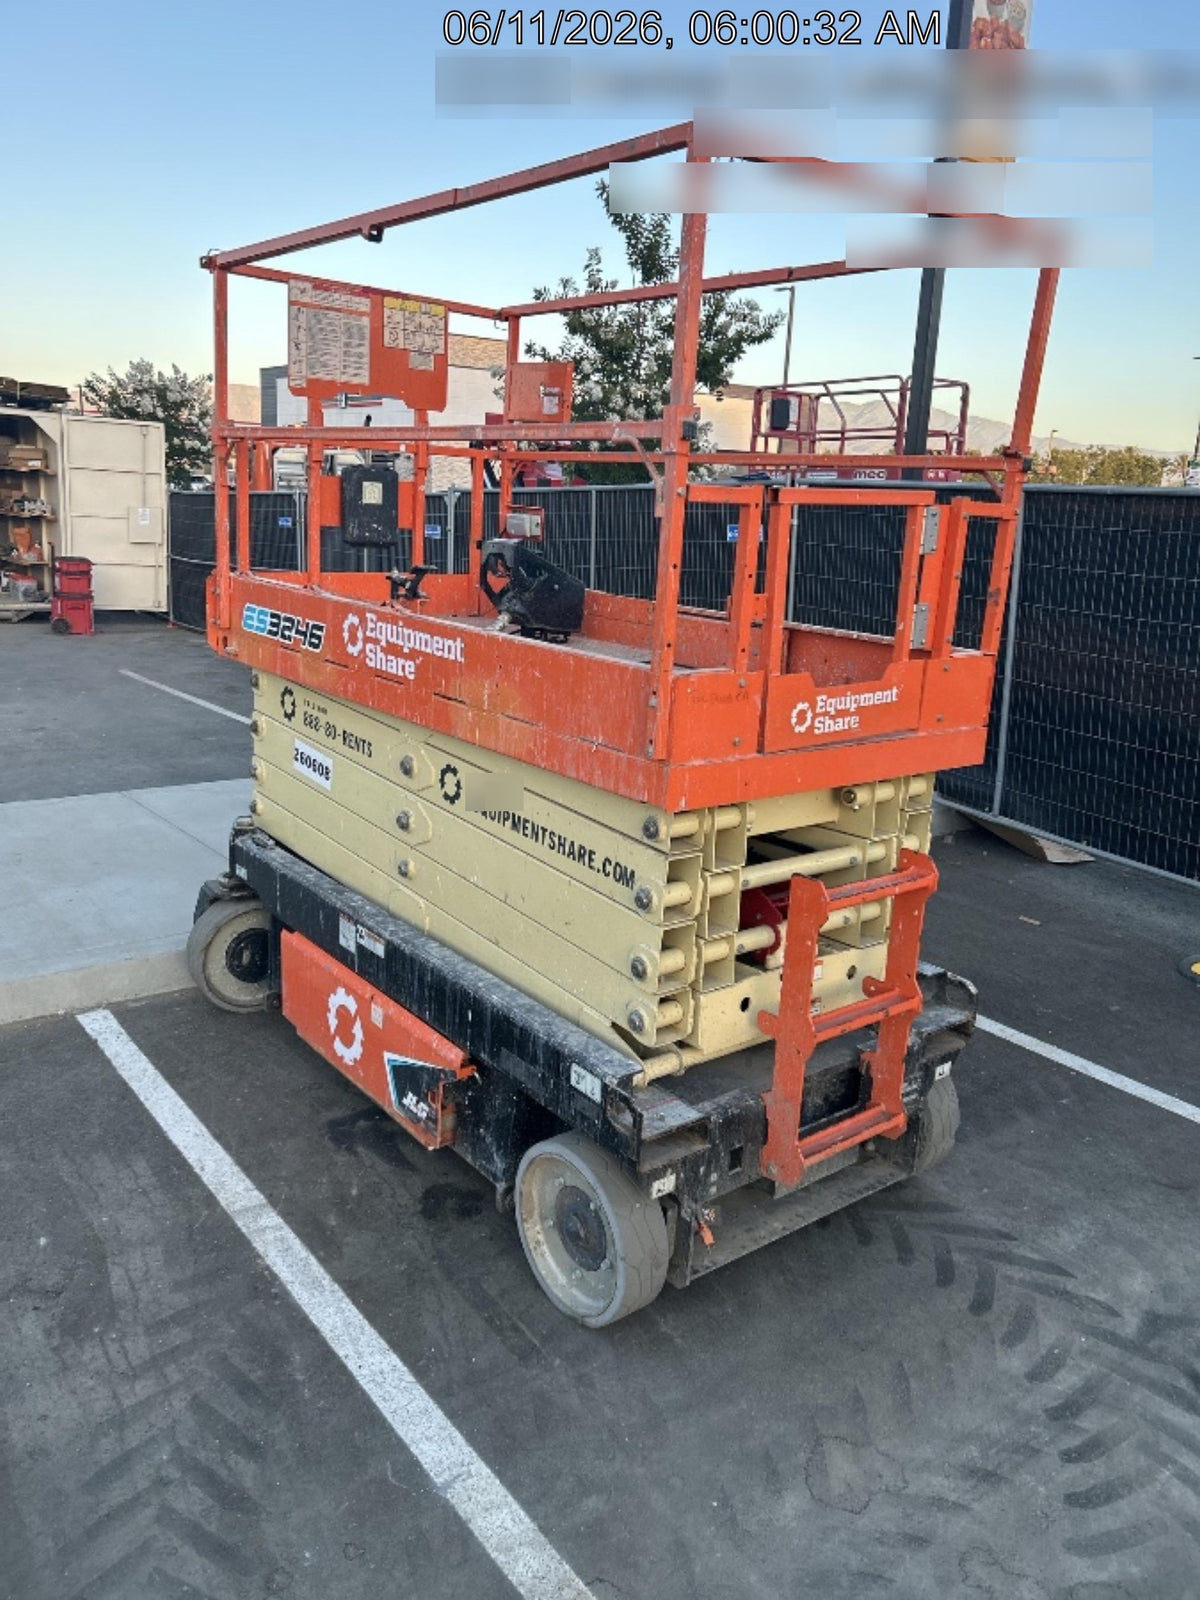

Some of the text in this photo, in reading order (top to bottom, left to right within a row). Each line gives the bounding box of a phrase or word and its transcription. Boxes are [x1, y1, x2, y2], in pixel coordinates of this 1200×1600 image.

[242, 603, 326, 652] ES3246
[365, 612, 465, 663] Equipment
[365, 643, 416, 680] Share
[815, 685, 899, 714] Equipment
[813, 713, 860, 735] Share
[474, 810, 636, 890] UIPMENTSHARE.COM
